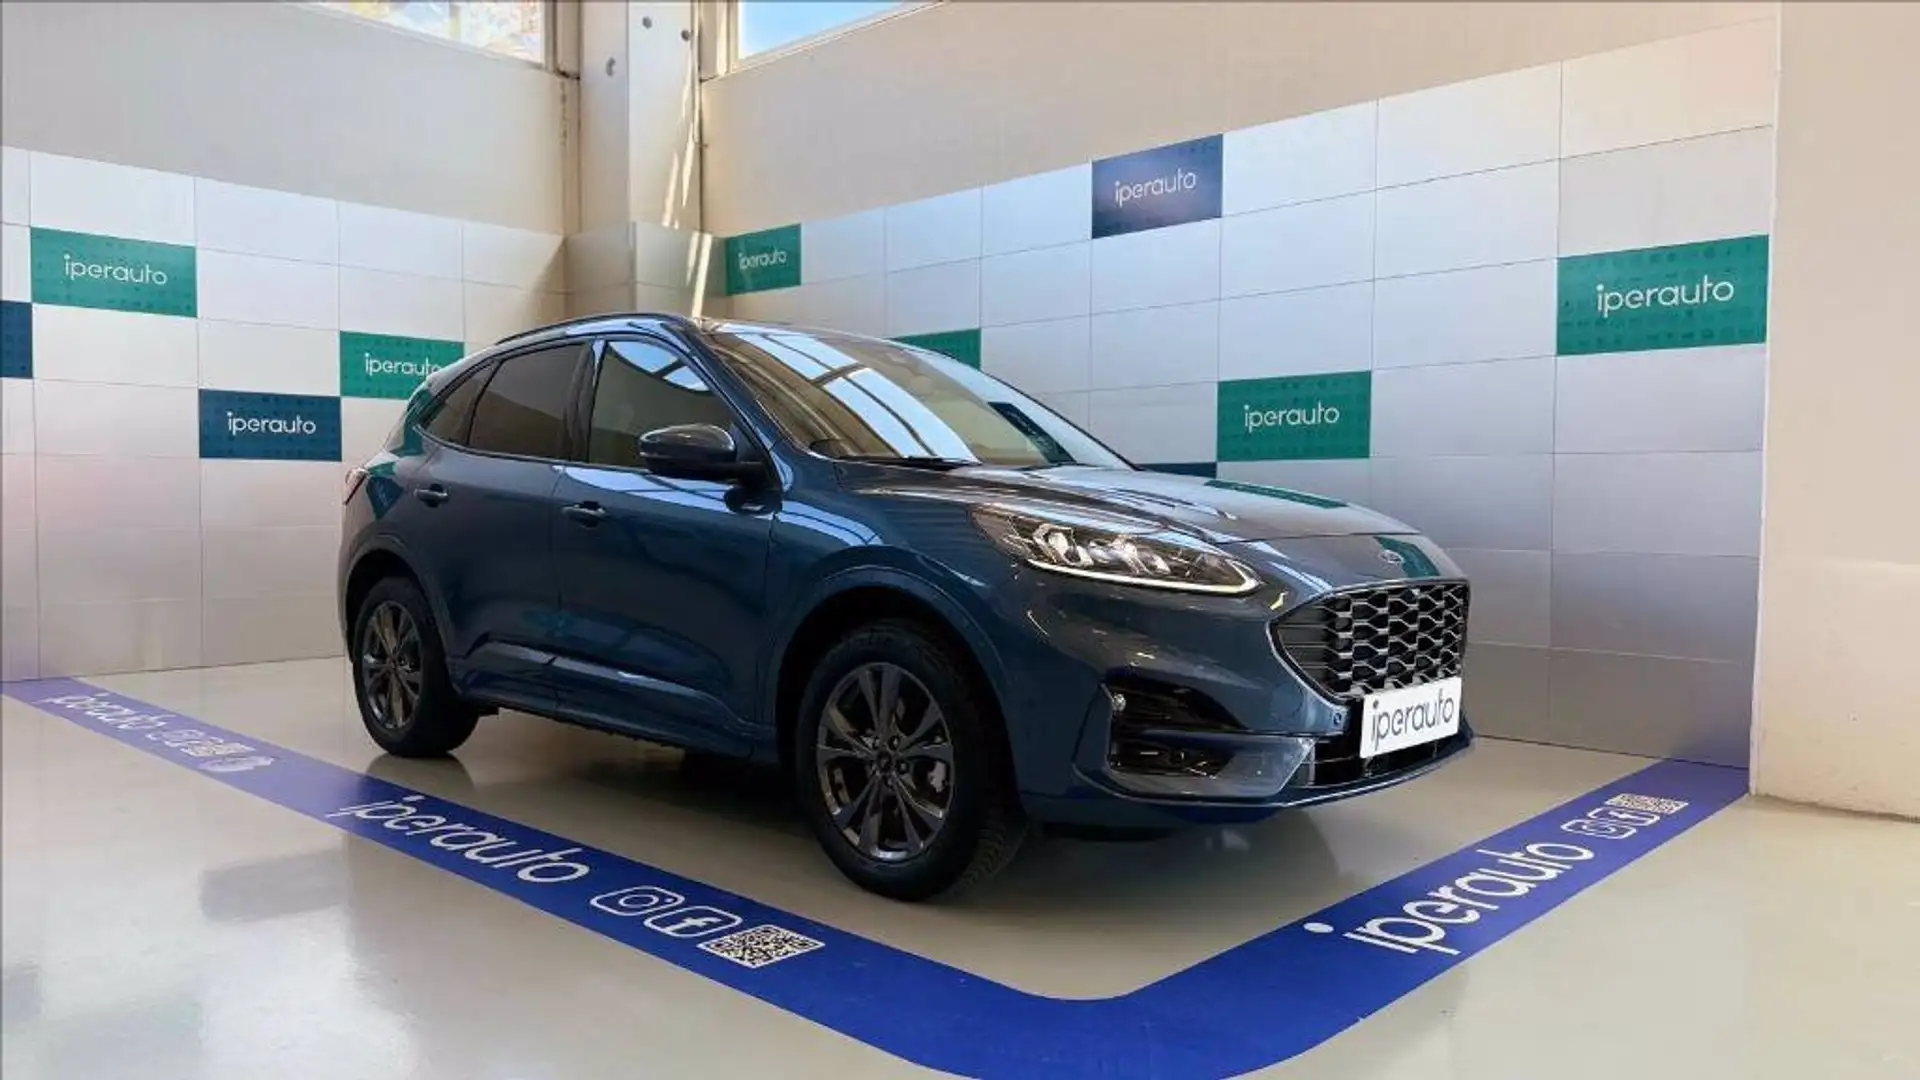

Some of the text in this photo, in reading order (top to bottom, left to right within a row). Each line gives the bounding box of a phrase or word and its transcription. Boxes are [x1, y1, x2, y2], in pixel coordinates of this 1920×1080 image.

[1114, 167, 1197, 208] iperauto
[63, 253, 168, 286] iperauto
[1596, 275, 1735, 318] iperauto
[227, 411, 317, 436] iperauto
[1244, 401, 1340, 434] iperauto
[1370, 688, 1455, 751] iperauto
[323, 795, 590, 883] iperauto
[1303, 841, 1596, 956] iperauto
